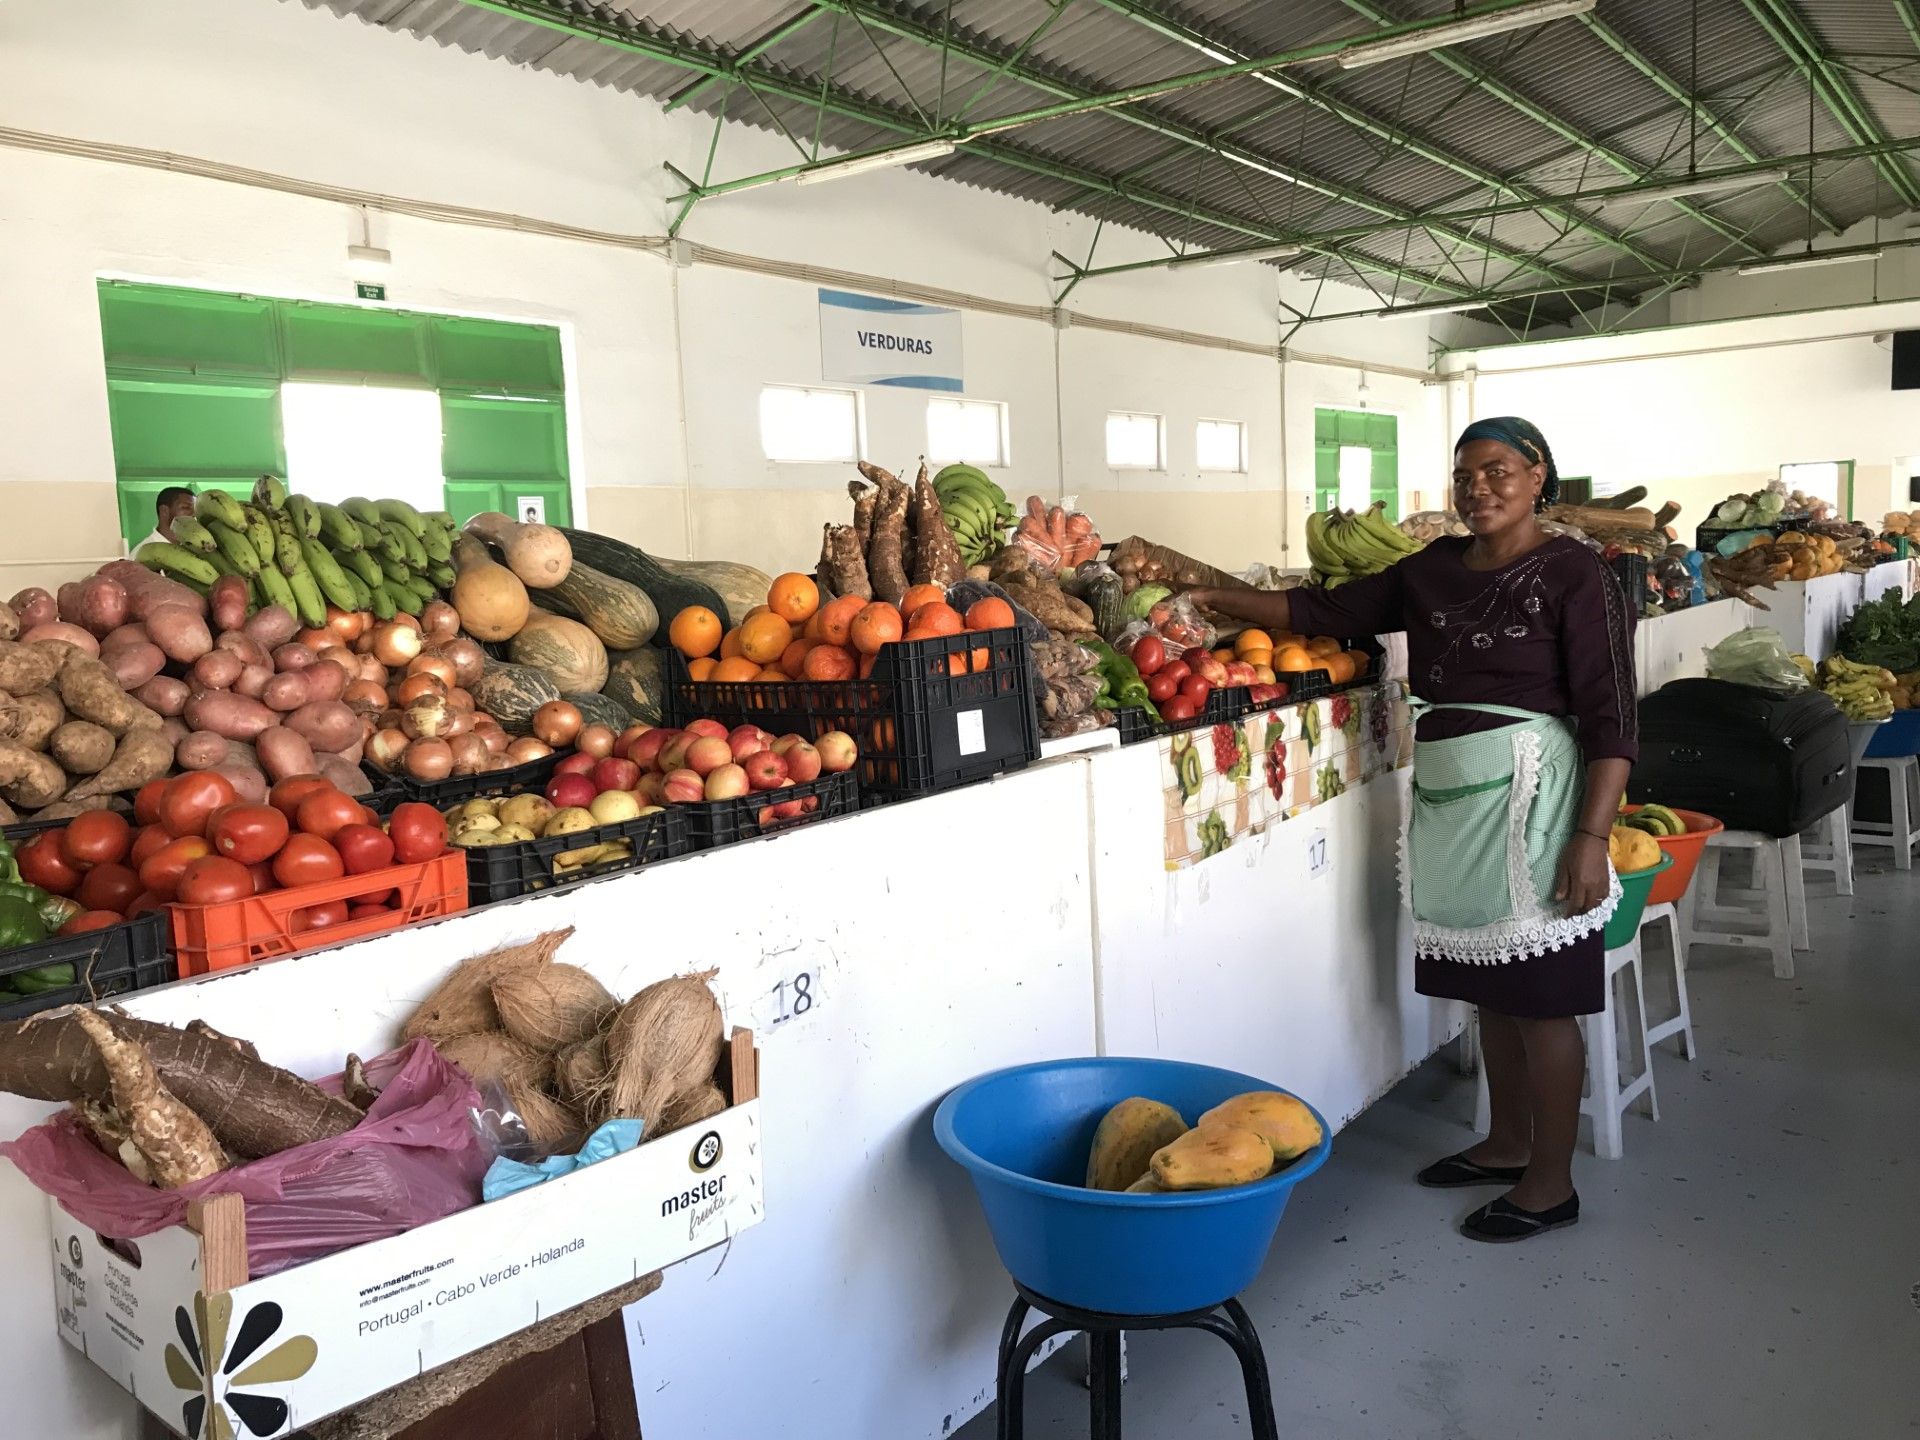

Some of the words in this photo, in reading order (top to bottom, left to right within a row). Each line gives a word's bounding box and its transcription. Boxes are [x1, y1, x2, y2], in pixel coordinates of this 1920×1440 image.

[857, 330, 933, 355] VERDURAS
[1309, 838, 1325, 871] 17
[772, 972, 812, 1024] 18
[661, 1175, 727, 1217] master
[689, 1194, 726, 1241] fruits
[60, 1263, 87, 1293] master
[104, 1273, 120, 1296] Cabo
[107, 1261, 131, 1287] Portugal
[358, 1299, 423, 1337] Portugal
[435, 1282, 476, 1306] Cabo
[479, 1264, 521, 1288] Verde
[531, 1238, 585, 1268] Holanda
[359, 1257, 455, 1297] www.masterfruits.com
[359, 1278, 431, 1308] info@masterfruits.com
